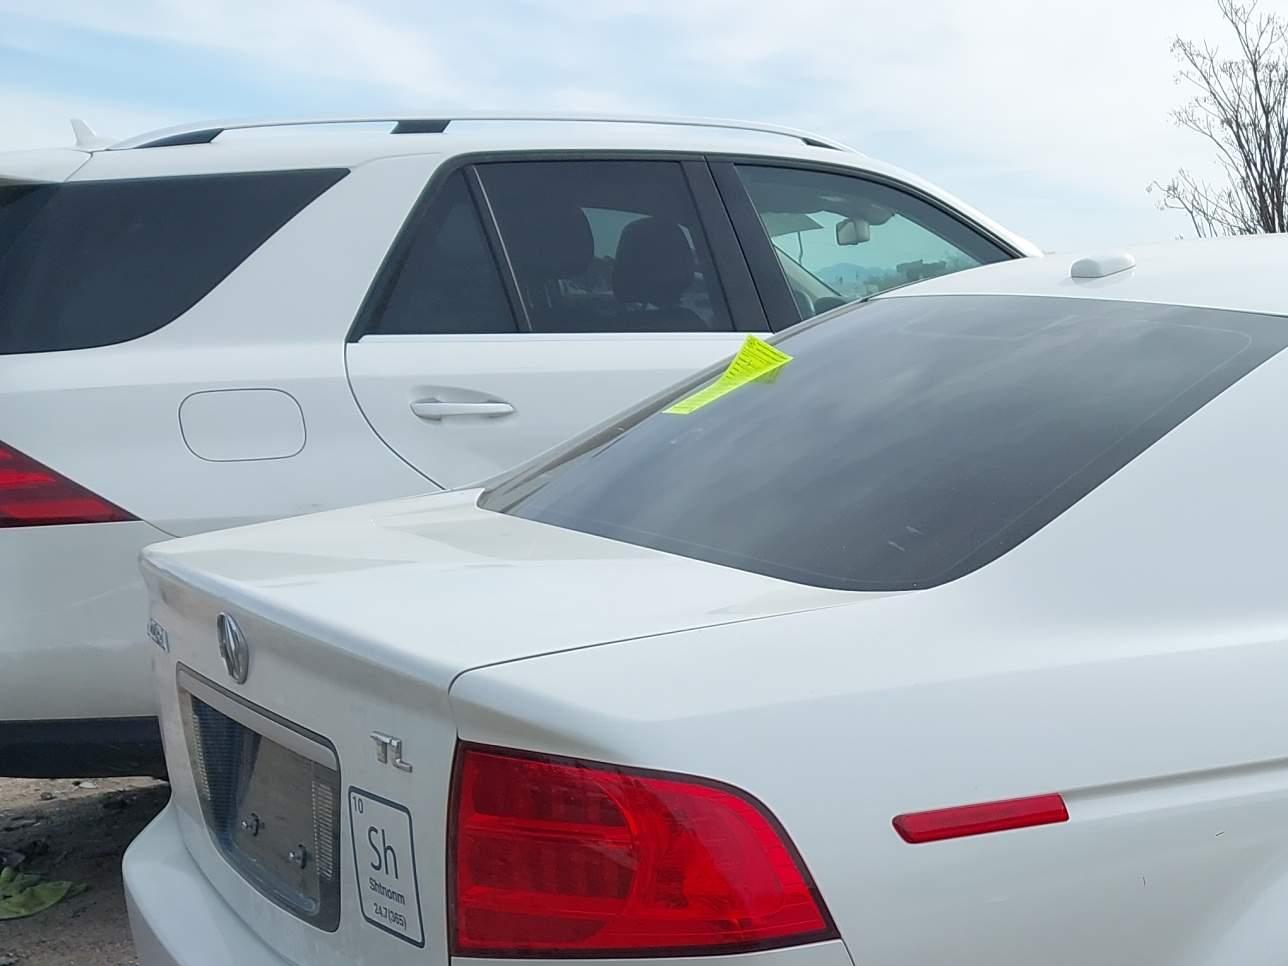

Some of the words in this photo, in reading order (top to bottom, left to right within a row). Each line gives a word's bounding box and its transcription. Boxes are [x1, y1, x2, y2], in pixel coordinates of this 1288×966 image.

[368, 730, 413, 773] TL
[351, 796, 364, 814] 10
[367, 825, 399, 880] Sh
